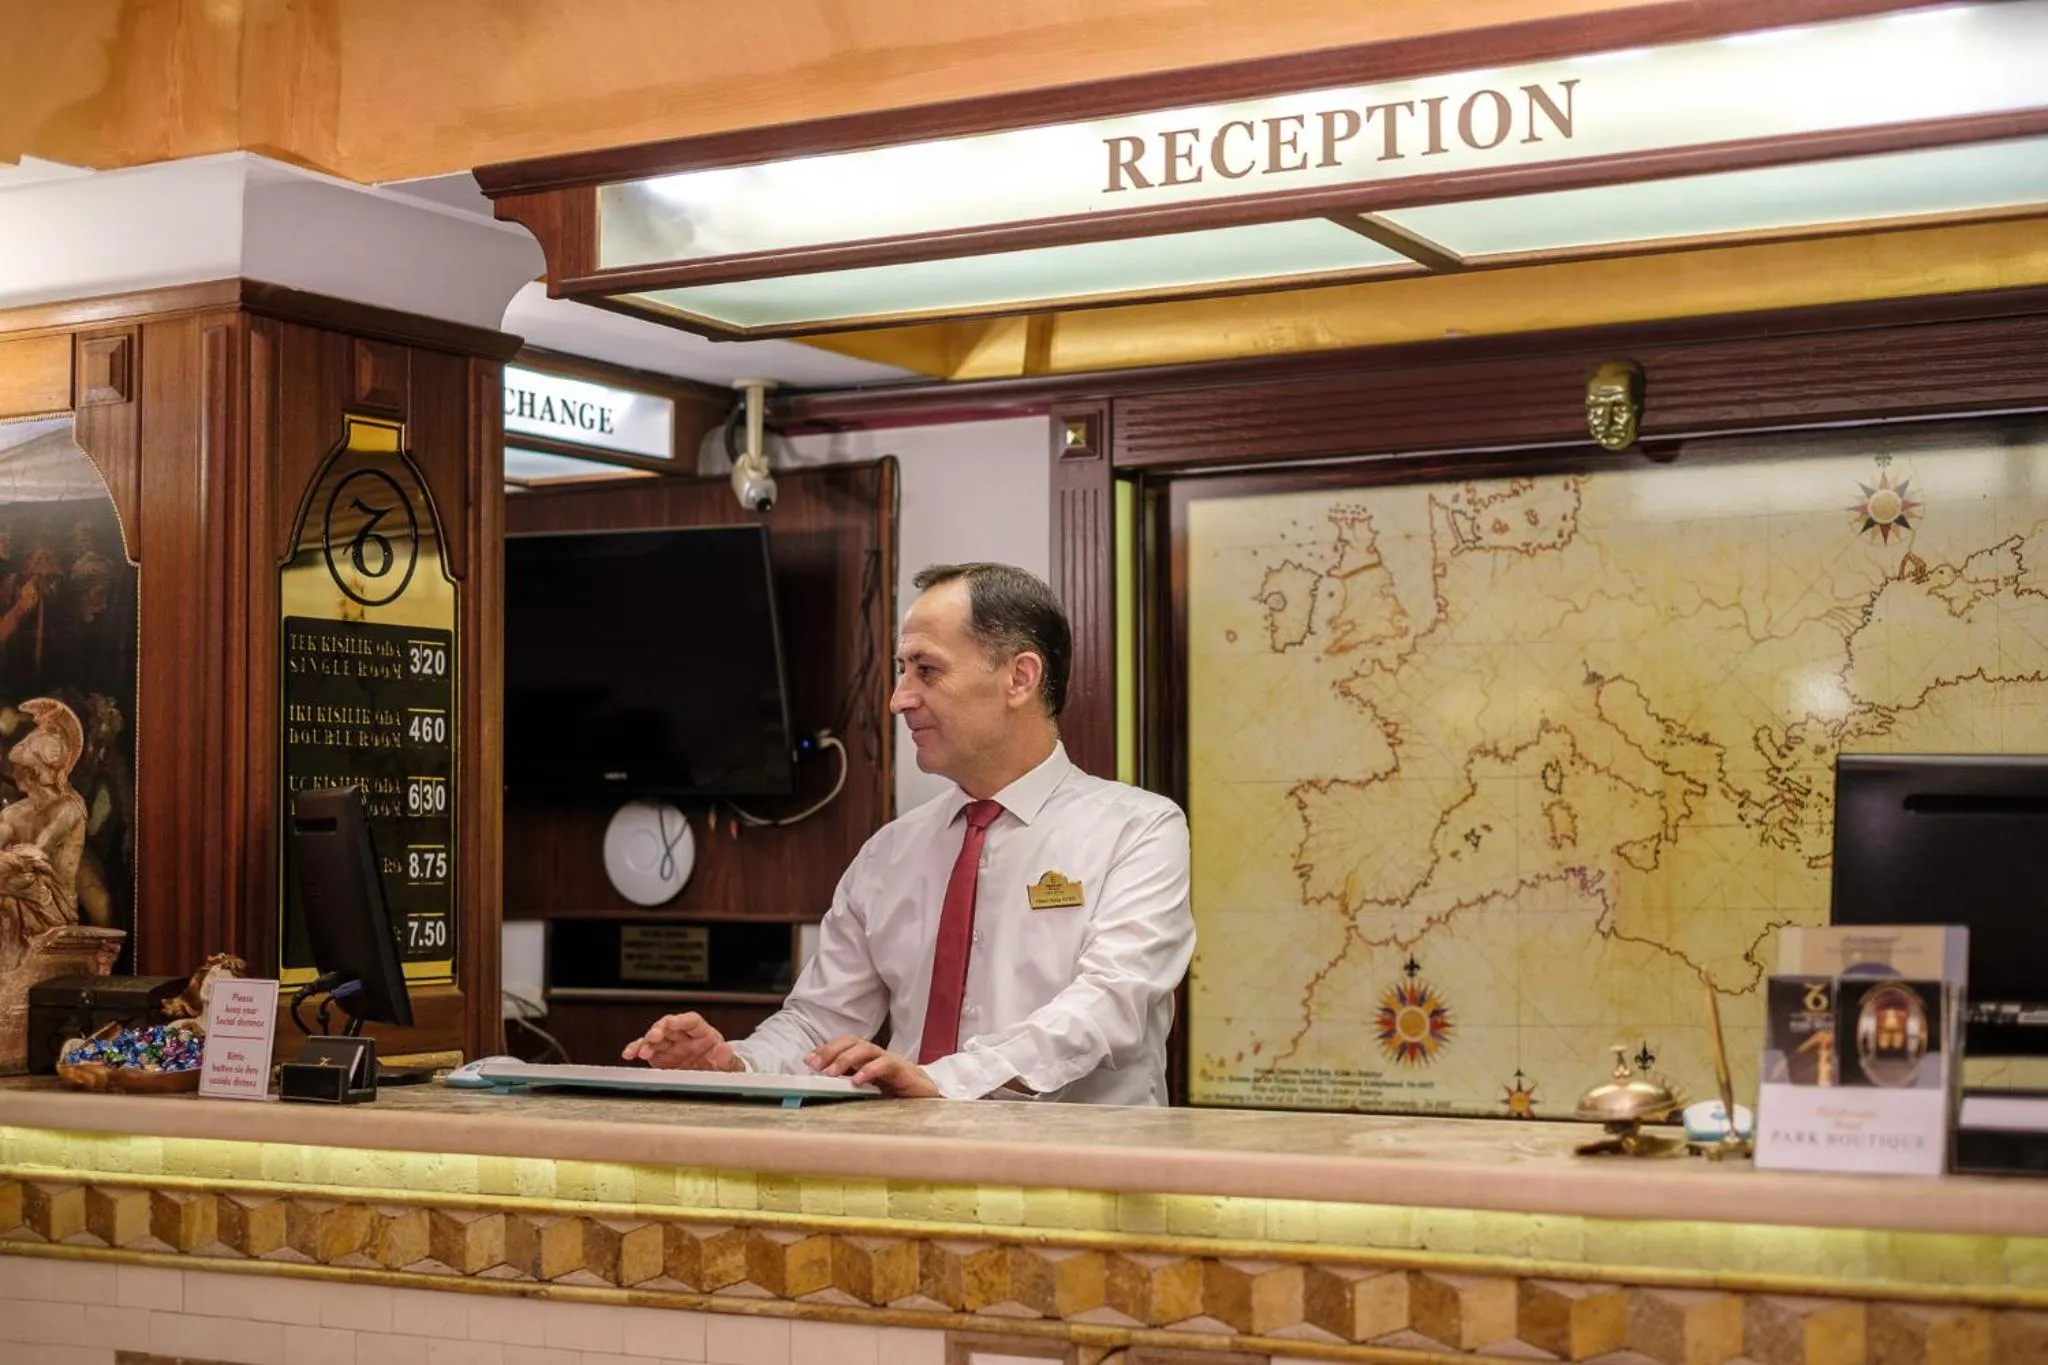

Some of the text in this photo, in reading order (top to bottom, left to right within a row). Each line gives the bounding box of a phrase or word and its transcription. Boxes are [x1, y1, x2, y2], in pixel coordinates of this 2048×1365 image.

[1101, 79, 1580, 194] RECEPTION
[290, 656, 402, 679] SINGLE ROOM
[410, 648, 445, 675] 320
[290, 727, 402, 748] DOUBLE ROOM
[409, 716, 445, 743] 460
[409, 784, 445, 810] 630
[409, 853, 447, 878] 8.75
[408, 920, 446, 946] 7.50
[1770, 1129, 1927, 1150] PARK BOUTIQUE
